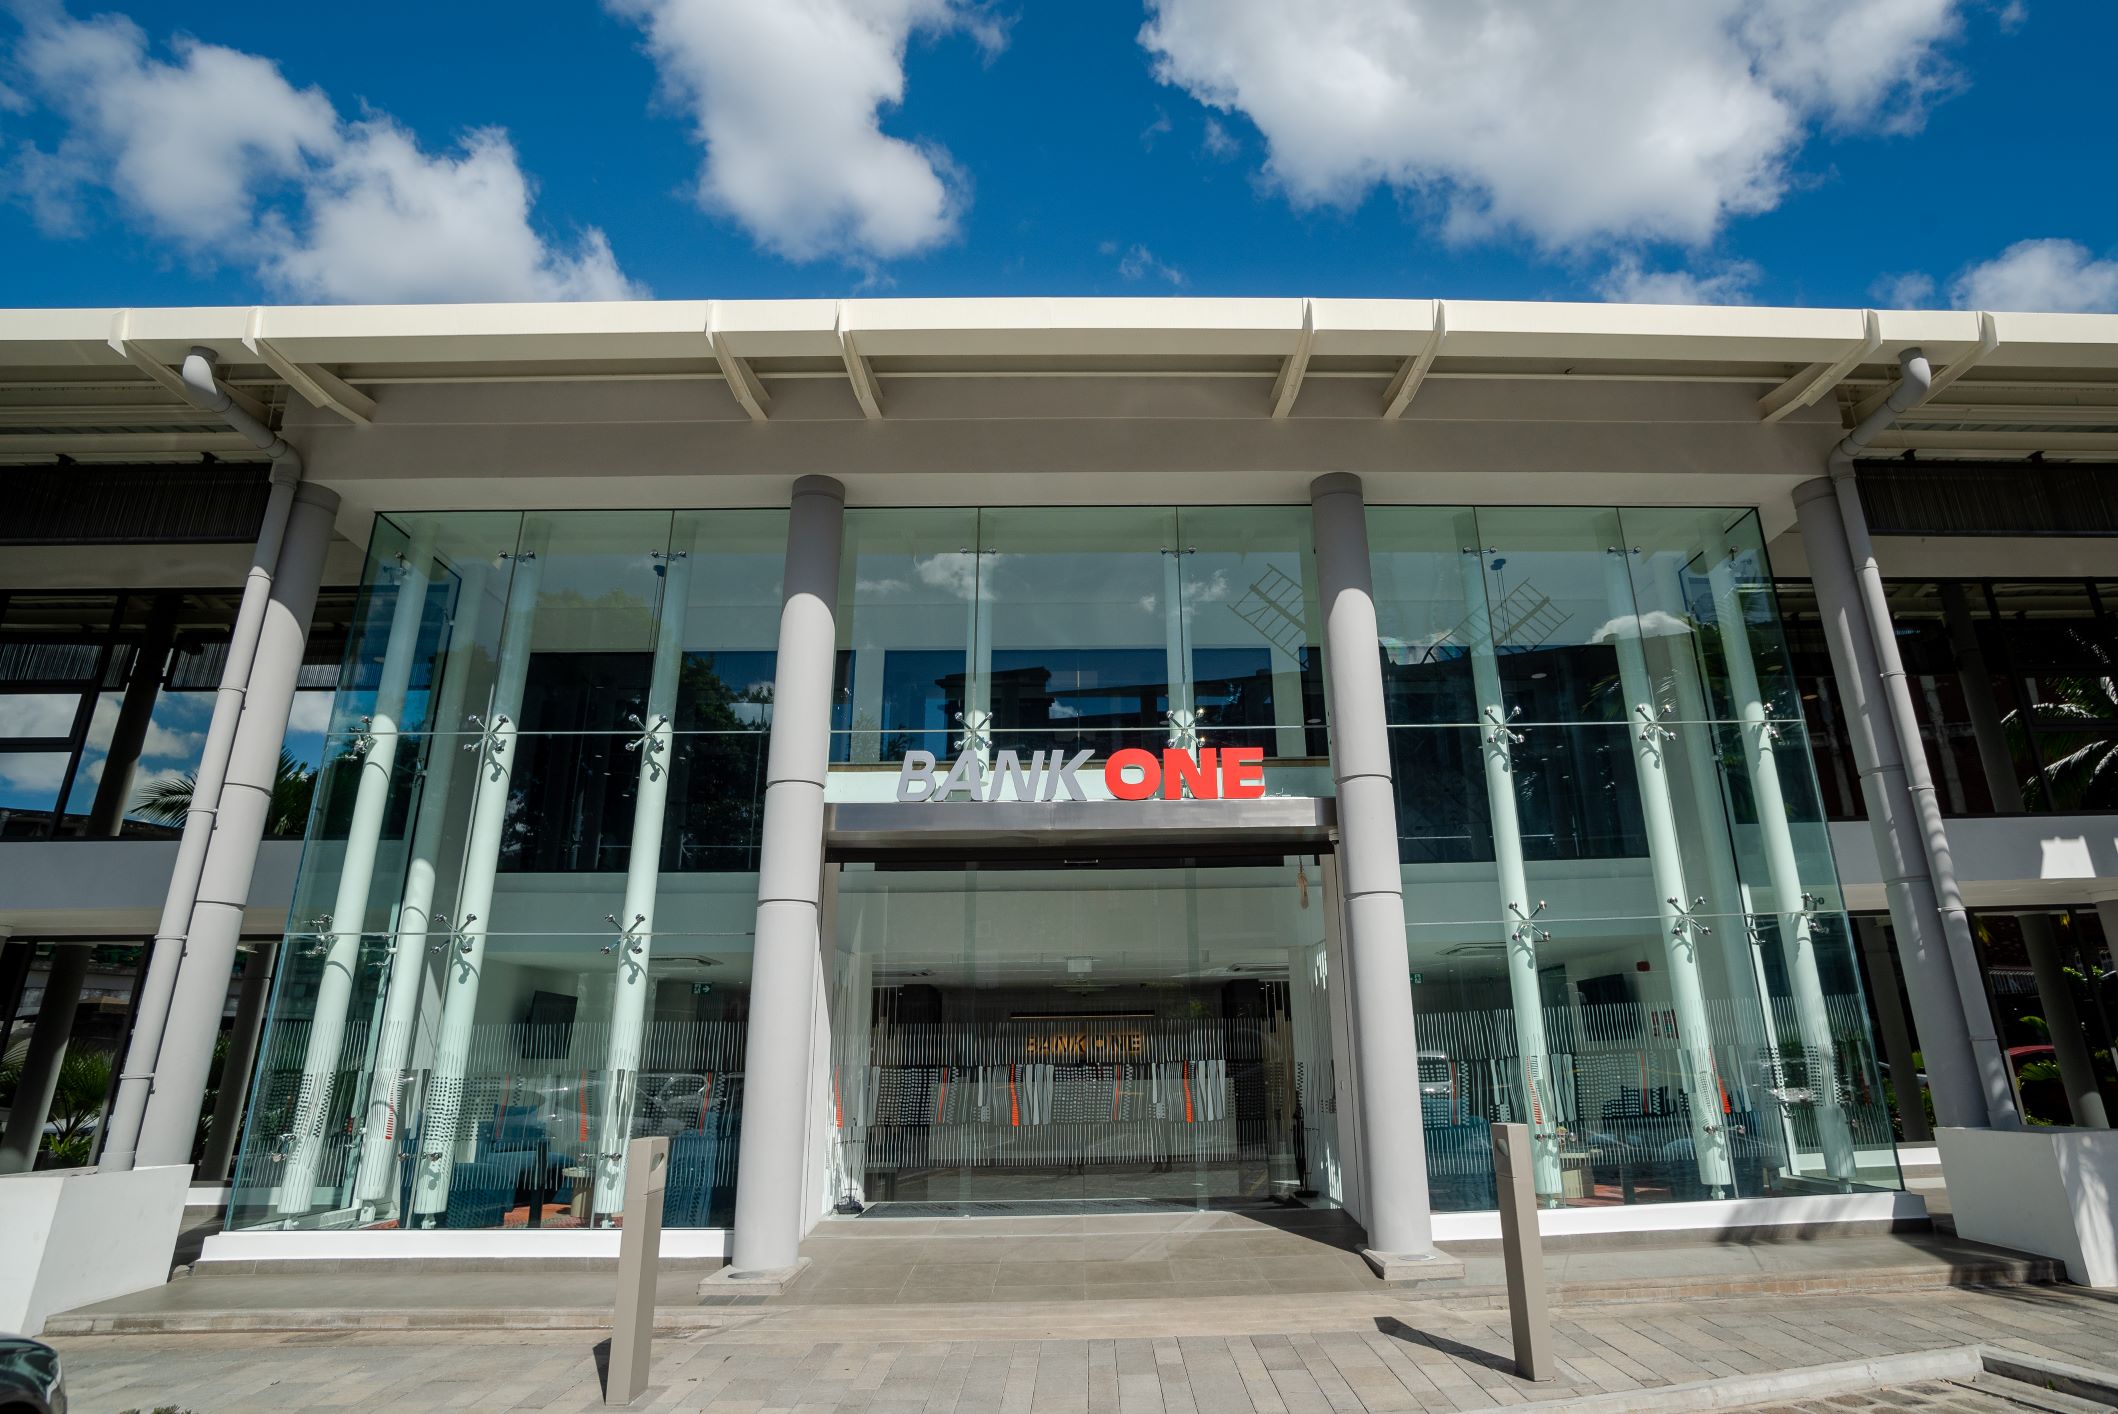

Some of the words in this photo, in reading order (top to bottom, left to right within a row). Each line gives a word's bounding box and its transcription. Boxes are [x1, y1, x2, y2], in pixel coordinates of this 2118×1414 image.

[896, 749, 1096, 802] BANK
[1104, 747, 1265, 800] ONE
[1026, 1034, 1087, 1054] BANK
